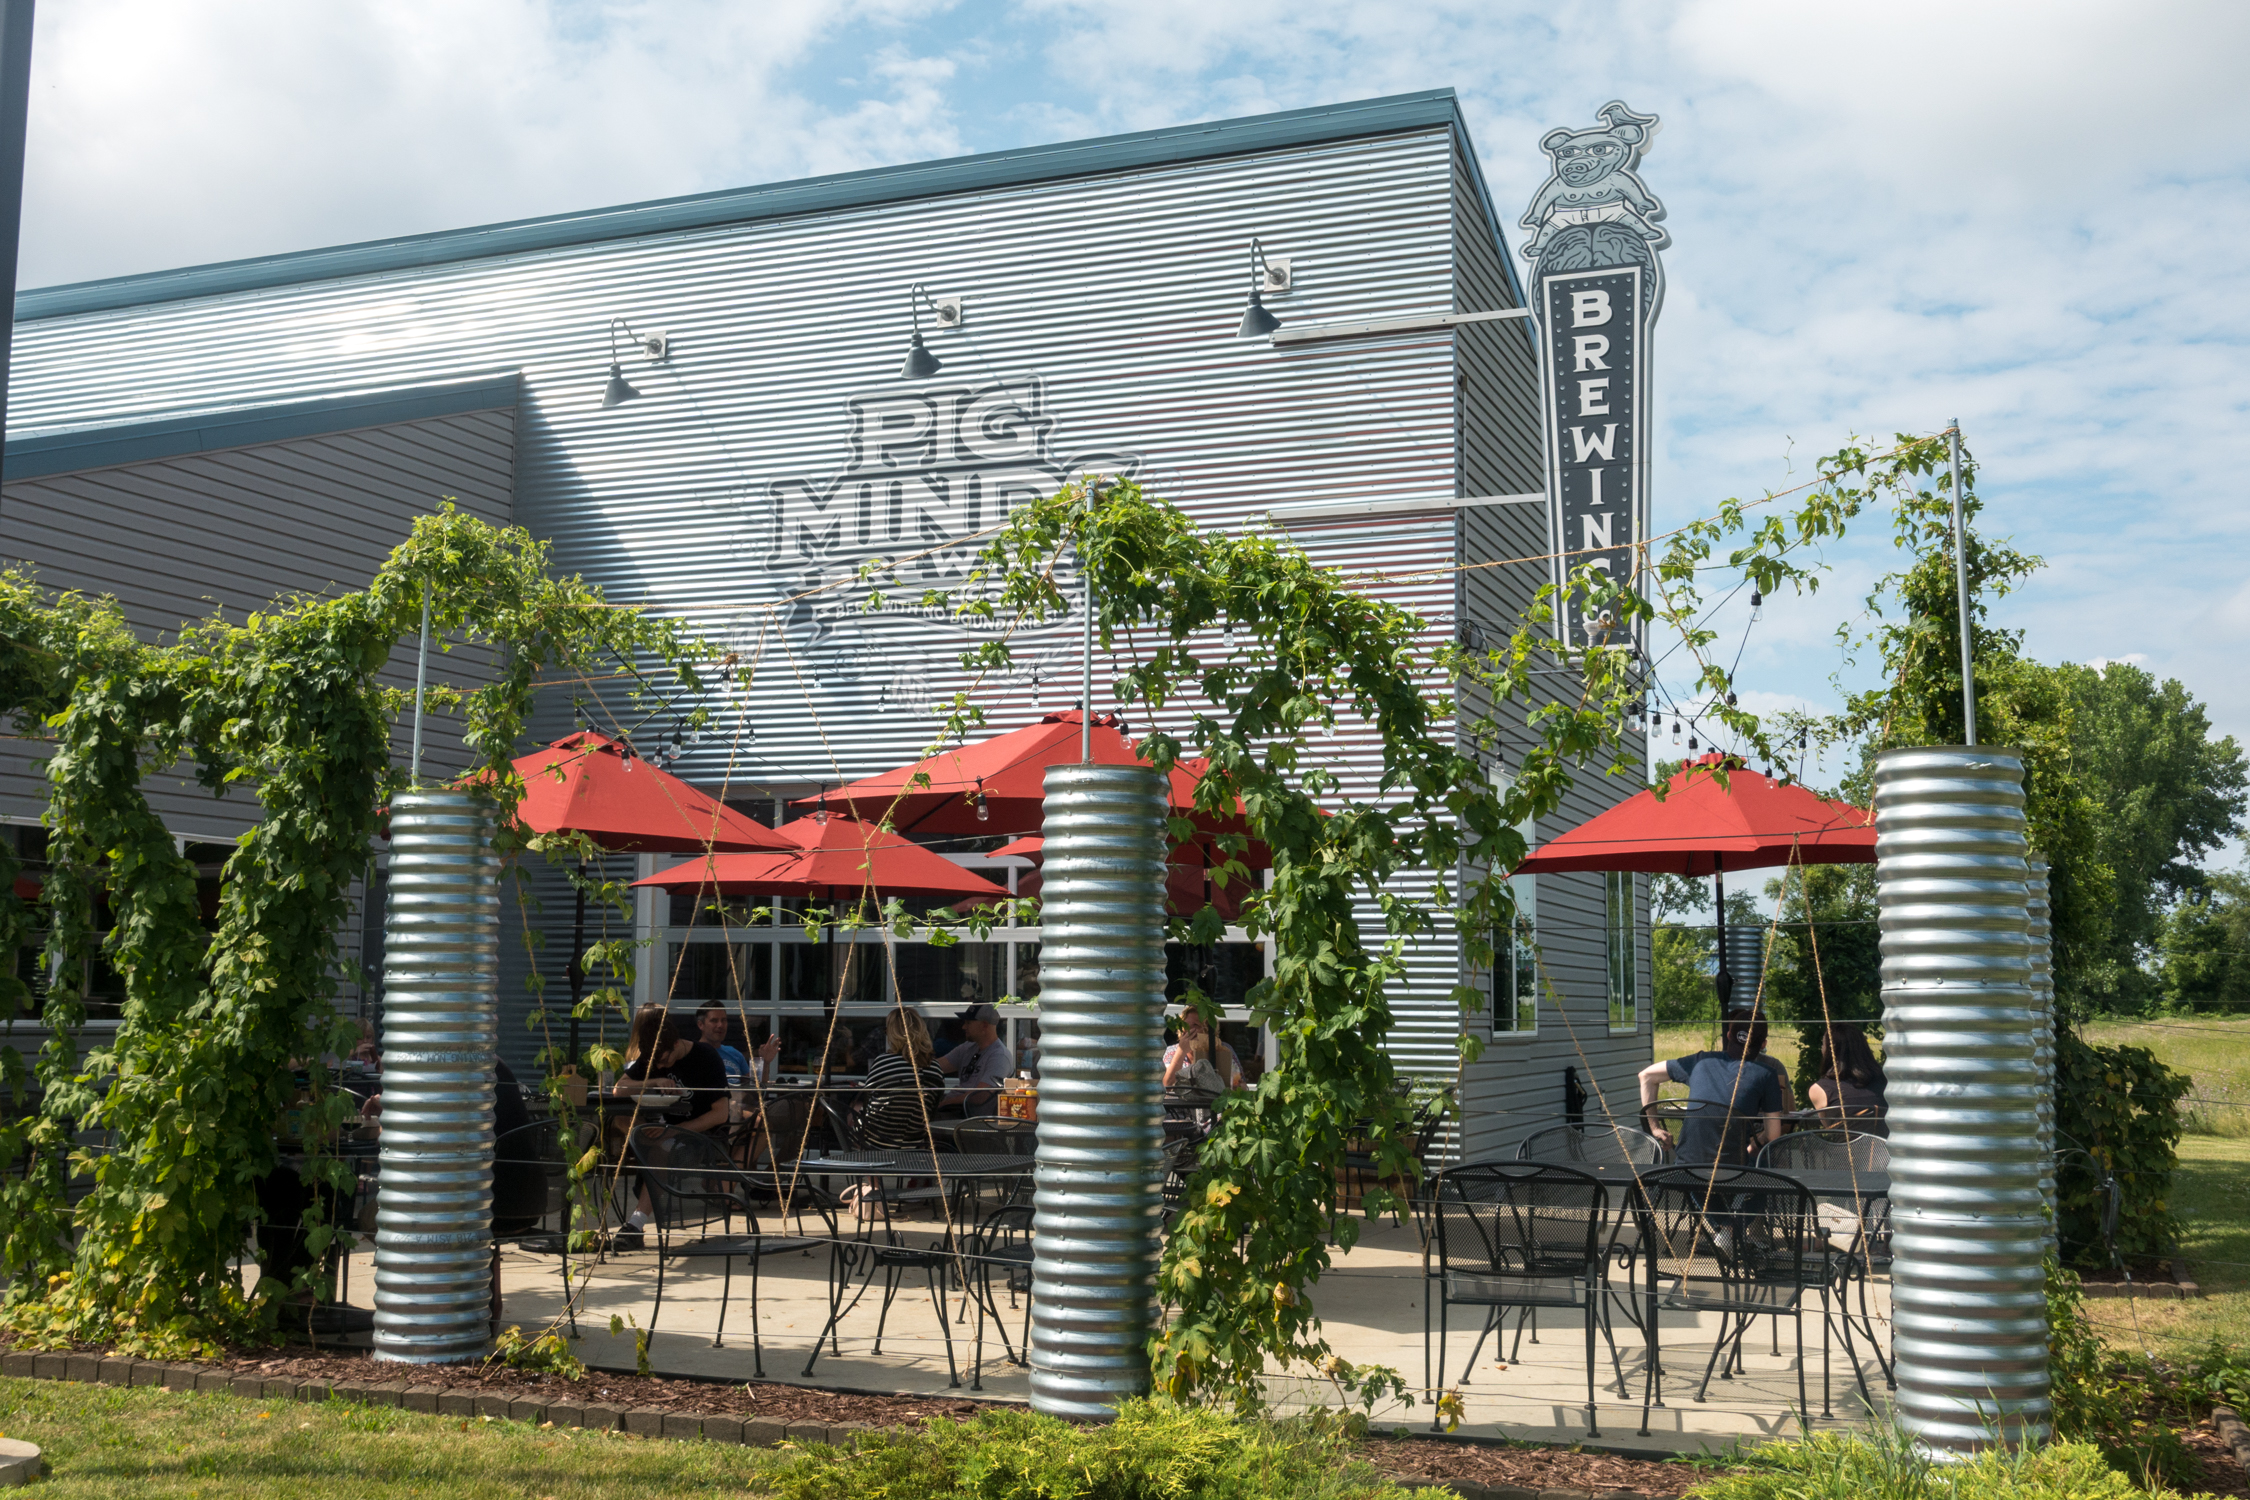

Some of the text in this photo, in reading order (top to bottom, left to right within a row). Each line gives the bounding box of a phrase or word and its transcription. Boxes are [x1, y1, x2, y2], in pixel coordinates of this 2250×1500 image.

[849, 374, 1059, 469] PIG
[803, 546, 1079, 600] BREWG
[882, 599, 919, 615] WITH
[922, 606, 946, 620] NO
